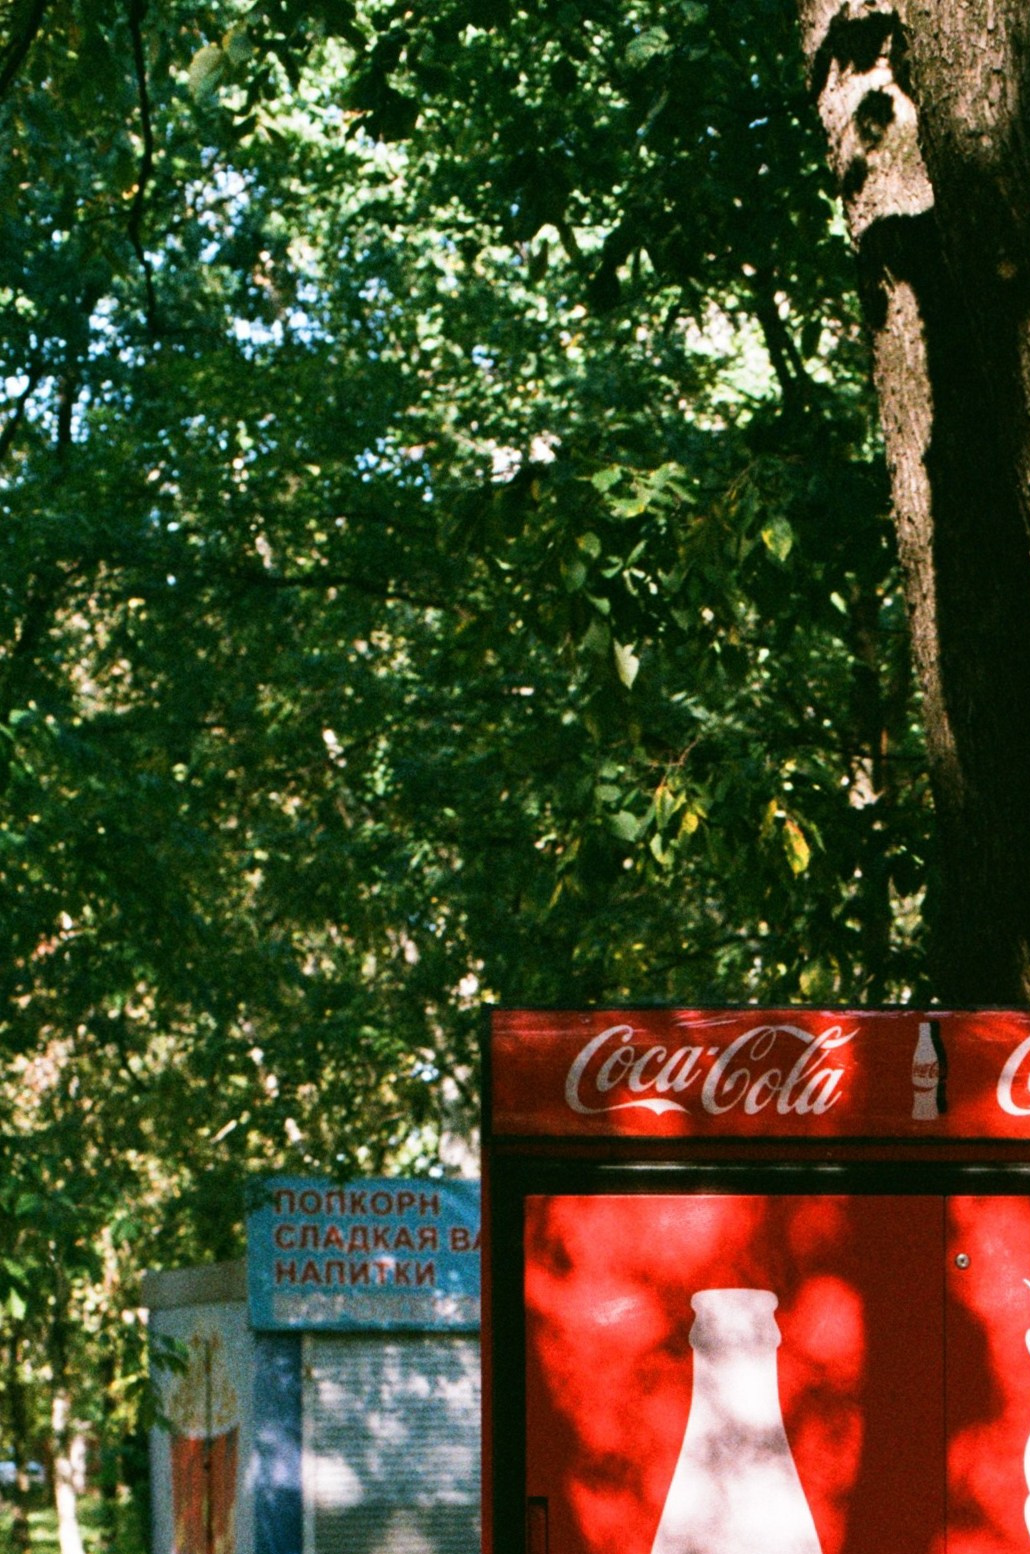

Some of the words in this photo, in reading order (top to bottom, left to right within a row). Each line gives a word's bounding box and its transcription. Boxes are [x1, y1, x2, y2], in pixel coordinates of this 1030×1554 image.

[565, 1024, 860, 1116] Coca-Cola
[274, 1188, 440, 1217] ПОПКОРН
[274, 1223, 438, 1253] СЛАДКАЯ
[275, 1259, 436, 1286] НАПИТКИ
